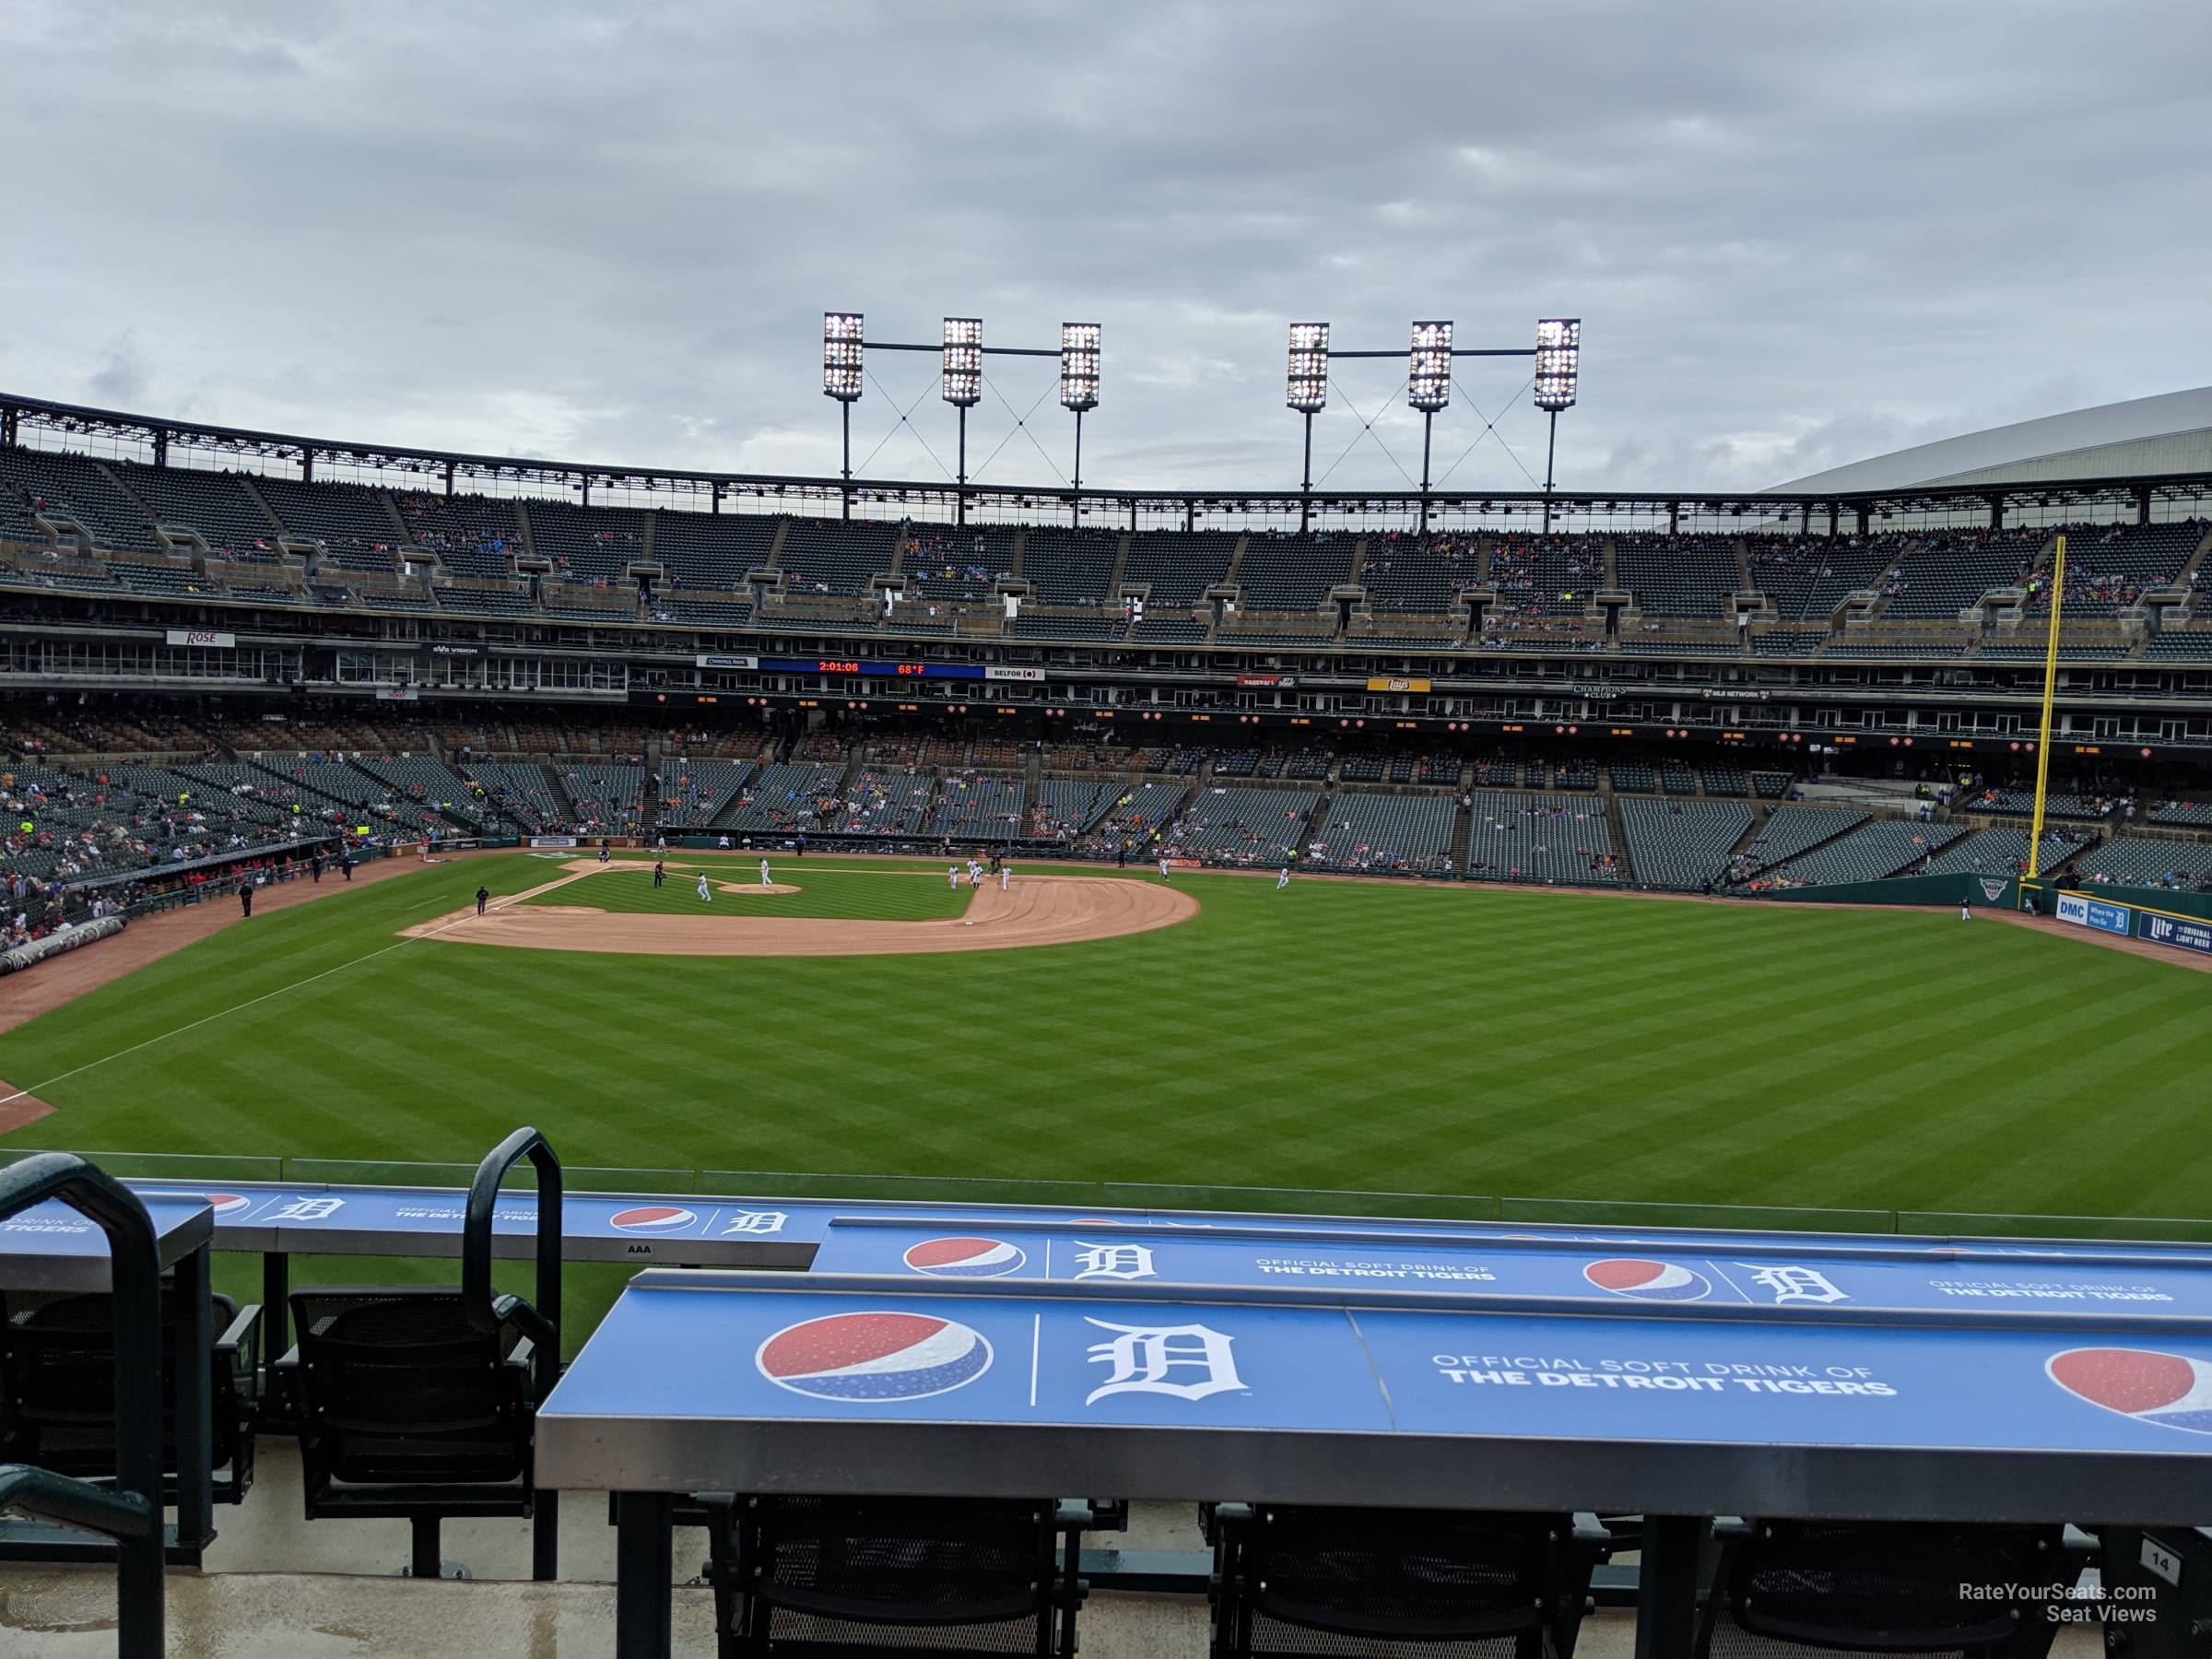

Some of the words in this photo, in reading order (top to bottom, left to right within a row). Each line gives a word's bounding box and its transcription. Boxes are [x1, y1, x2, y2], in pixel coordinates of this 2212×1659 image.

[186, 632, 217, 644] ROSE
[818, 661, 859, 672] 2:01:06
[994, 669, 1021, 677] BELFOR
[1389, 679, 1409, 690] Lay's
[1573, 685, 1627, 693] CHAMPIONS
[2060, 901, 2085, 918] DMC
[2090, 906, 2105, 916] Where
[2150, 917, 2173, 939] Lite
[2183, 926, 2212, 939] ORIGINAL
[2176, 934, 2193, 945] LIGHT
[2194, 937, 2210, 948] BEER
[5, 1225, 90, 1233] TIGERS
[628, 1245, 652, 1254] AAA
[1256, 1258, 1337, 1268] OFFICIAL
[1345, 1262, 1394, 1270] SOFT
[1400, 1264, 1458, 1272] DRINK
[1464, 1265, 1489, 1274] OF
[1258, 1265, 1306, 1274] THE
[1309, 1267, 1406, 1278] DETROIT
[1412, 1272, 1497, 1281] TIGERS
[1929, 1280, 2009, 1289] OFFICIAL
[2016, 1282, 2066, 1290] SOFT
[2069, 1284, 2128, 1292] DRINK
[1937, 1288, 1988, 1297] THE
[1989, 1289, 2087, 1299] DETROIT
[2088, 1291, 2174, 1301] TIGERS
[1432, 1355, 1593, 1371] OFFICIAL
[1600, 1359, 1690, 1373] SOFT
[1705, 1363, 1818, 1377] DRINK
[1826, 1367, 1873, 1379] OF
[1439, 1369, 1533, 1385] THE
[1535, 1371, 1725, 1392] DETROIT
[1733, 1379, 1898, 1396] TIGERS
[2151, 1552, 2170, 1572] 14
